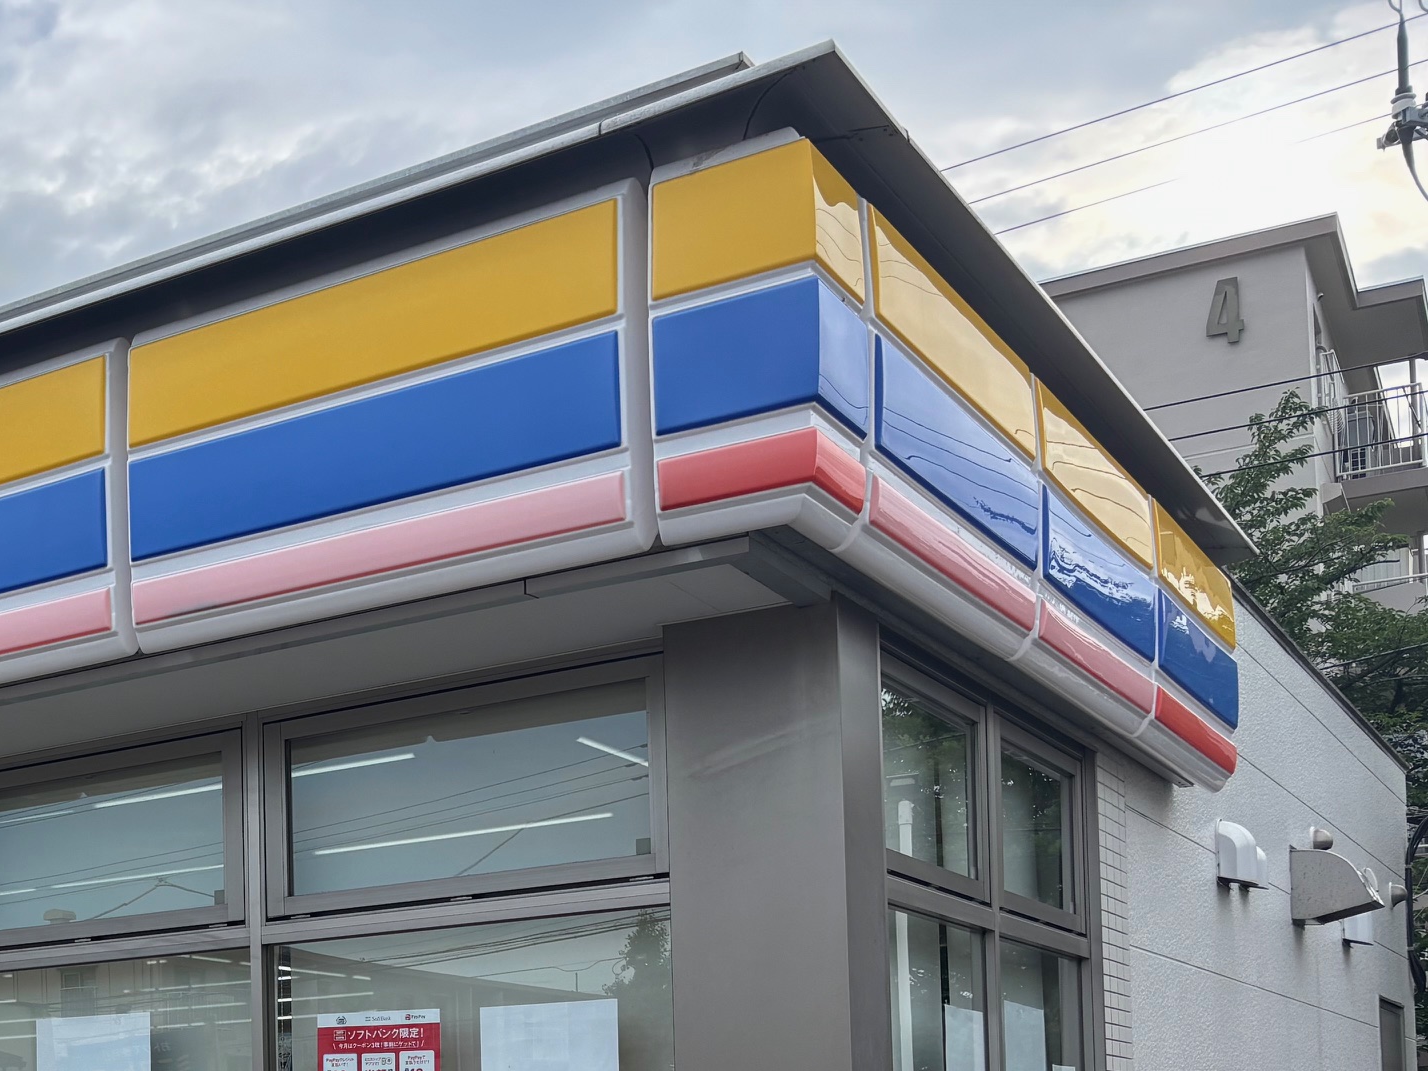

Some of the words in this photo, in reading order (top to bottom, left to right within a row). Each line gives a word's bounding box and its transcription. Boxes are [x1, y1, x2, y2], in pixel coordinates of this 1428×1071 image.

[1206, 276, 1244, 343] 4
[347, 1028, 424, 1040] ソフトバンク限定!
